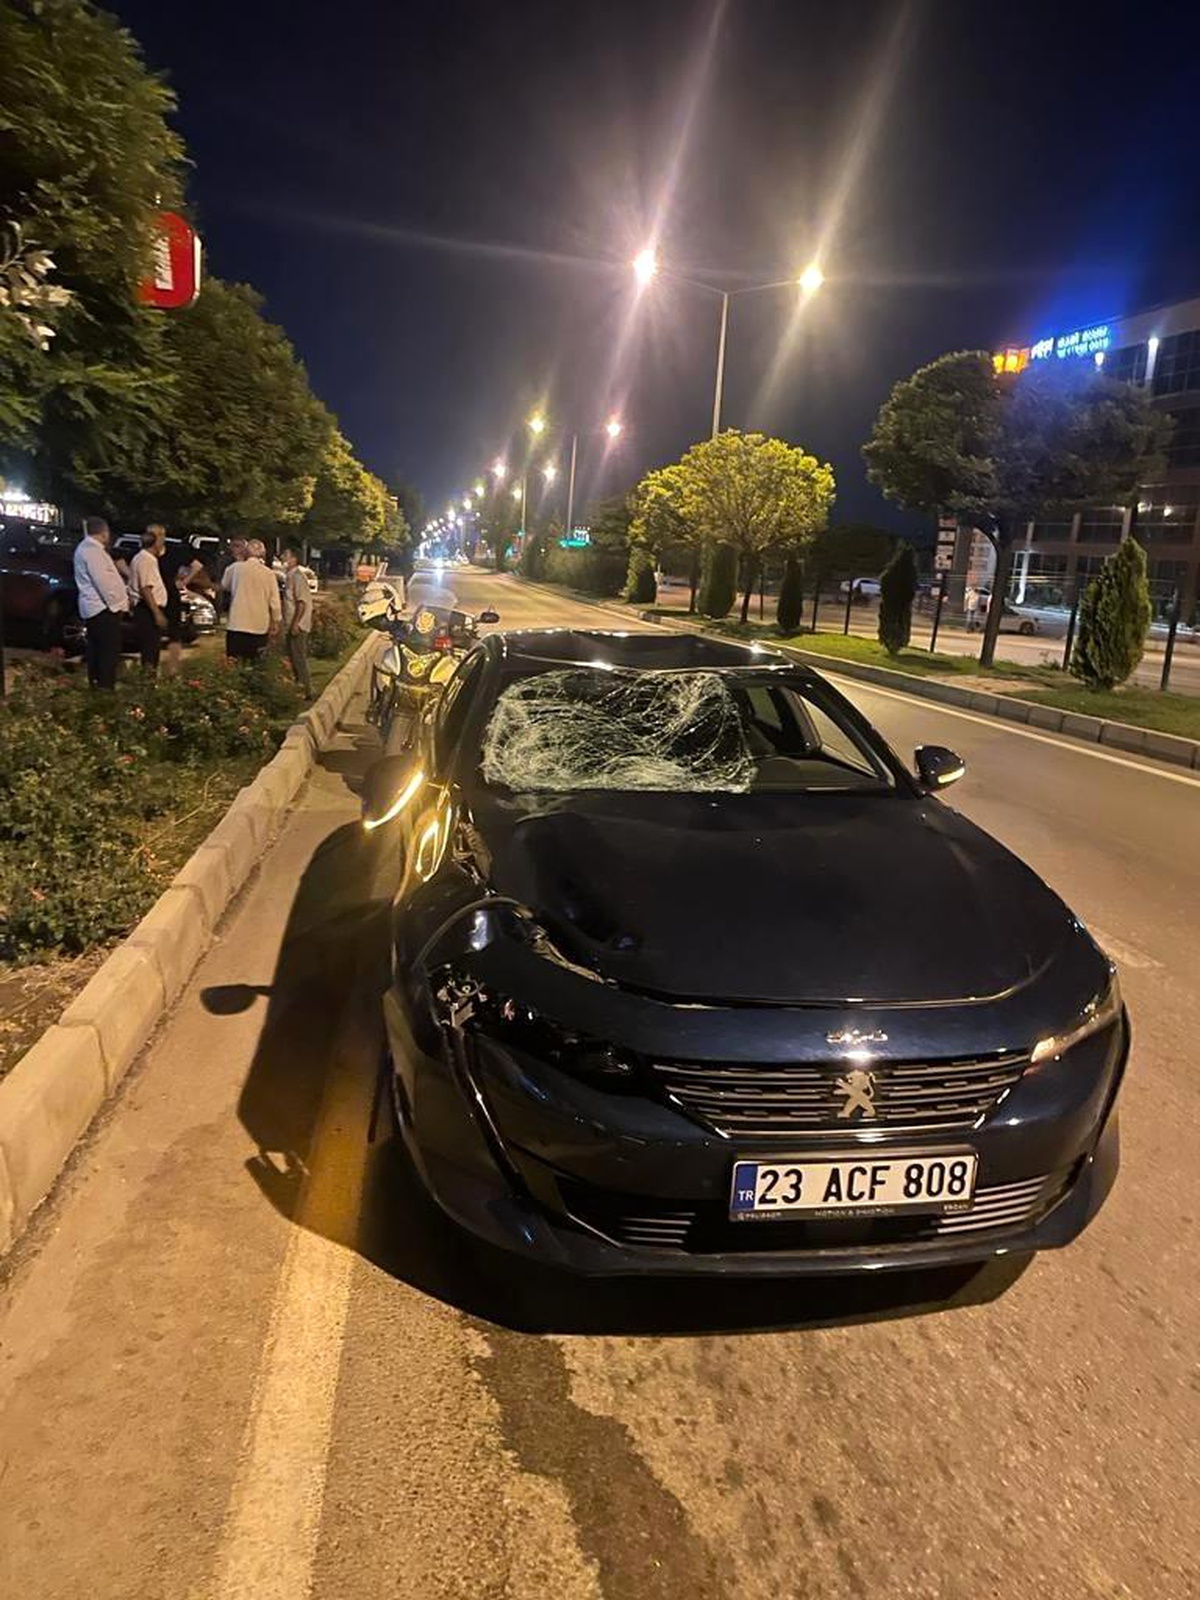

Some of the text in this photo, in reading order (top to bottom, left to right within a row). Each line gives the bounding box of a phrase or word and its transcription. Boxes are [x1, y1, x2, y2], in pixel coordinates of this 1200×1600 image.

[738, 1161, 968, 1205] TR 23 ACF 808
